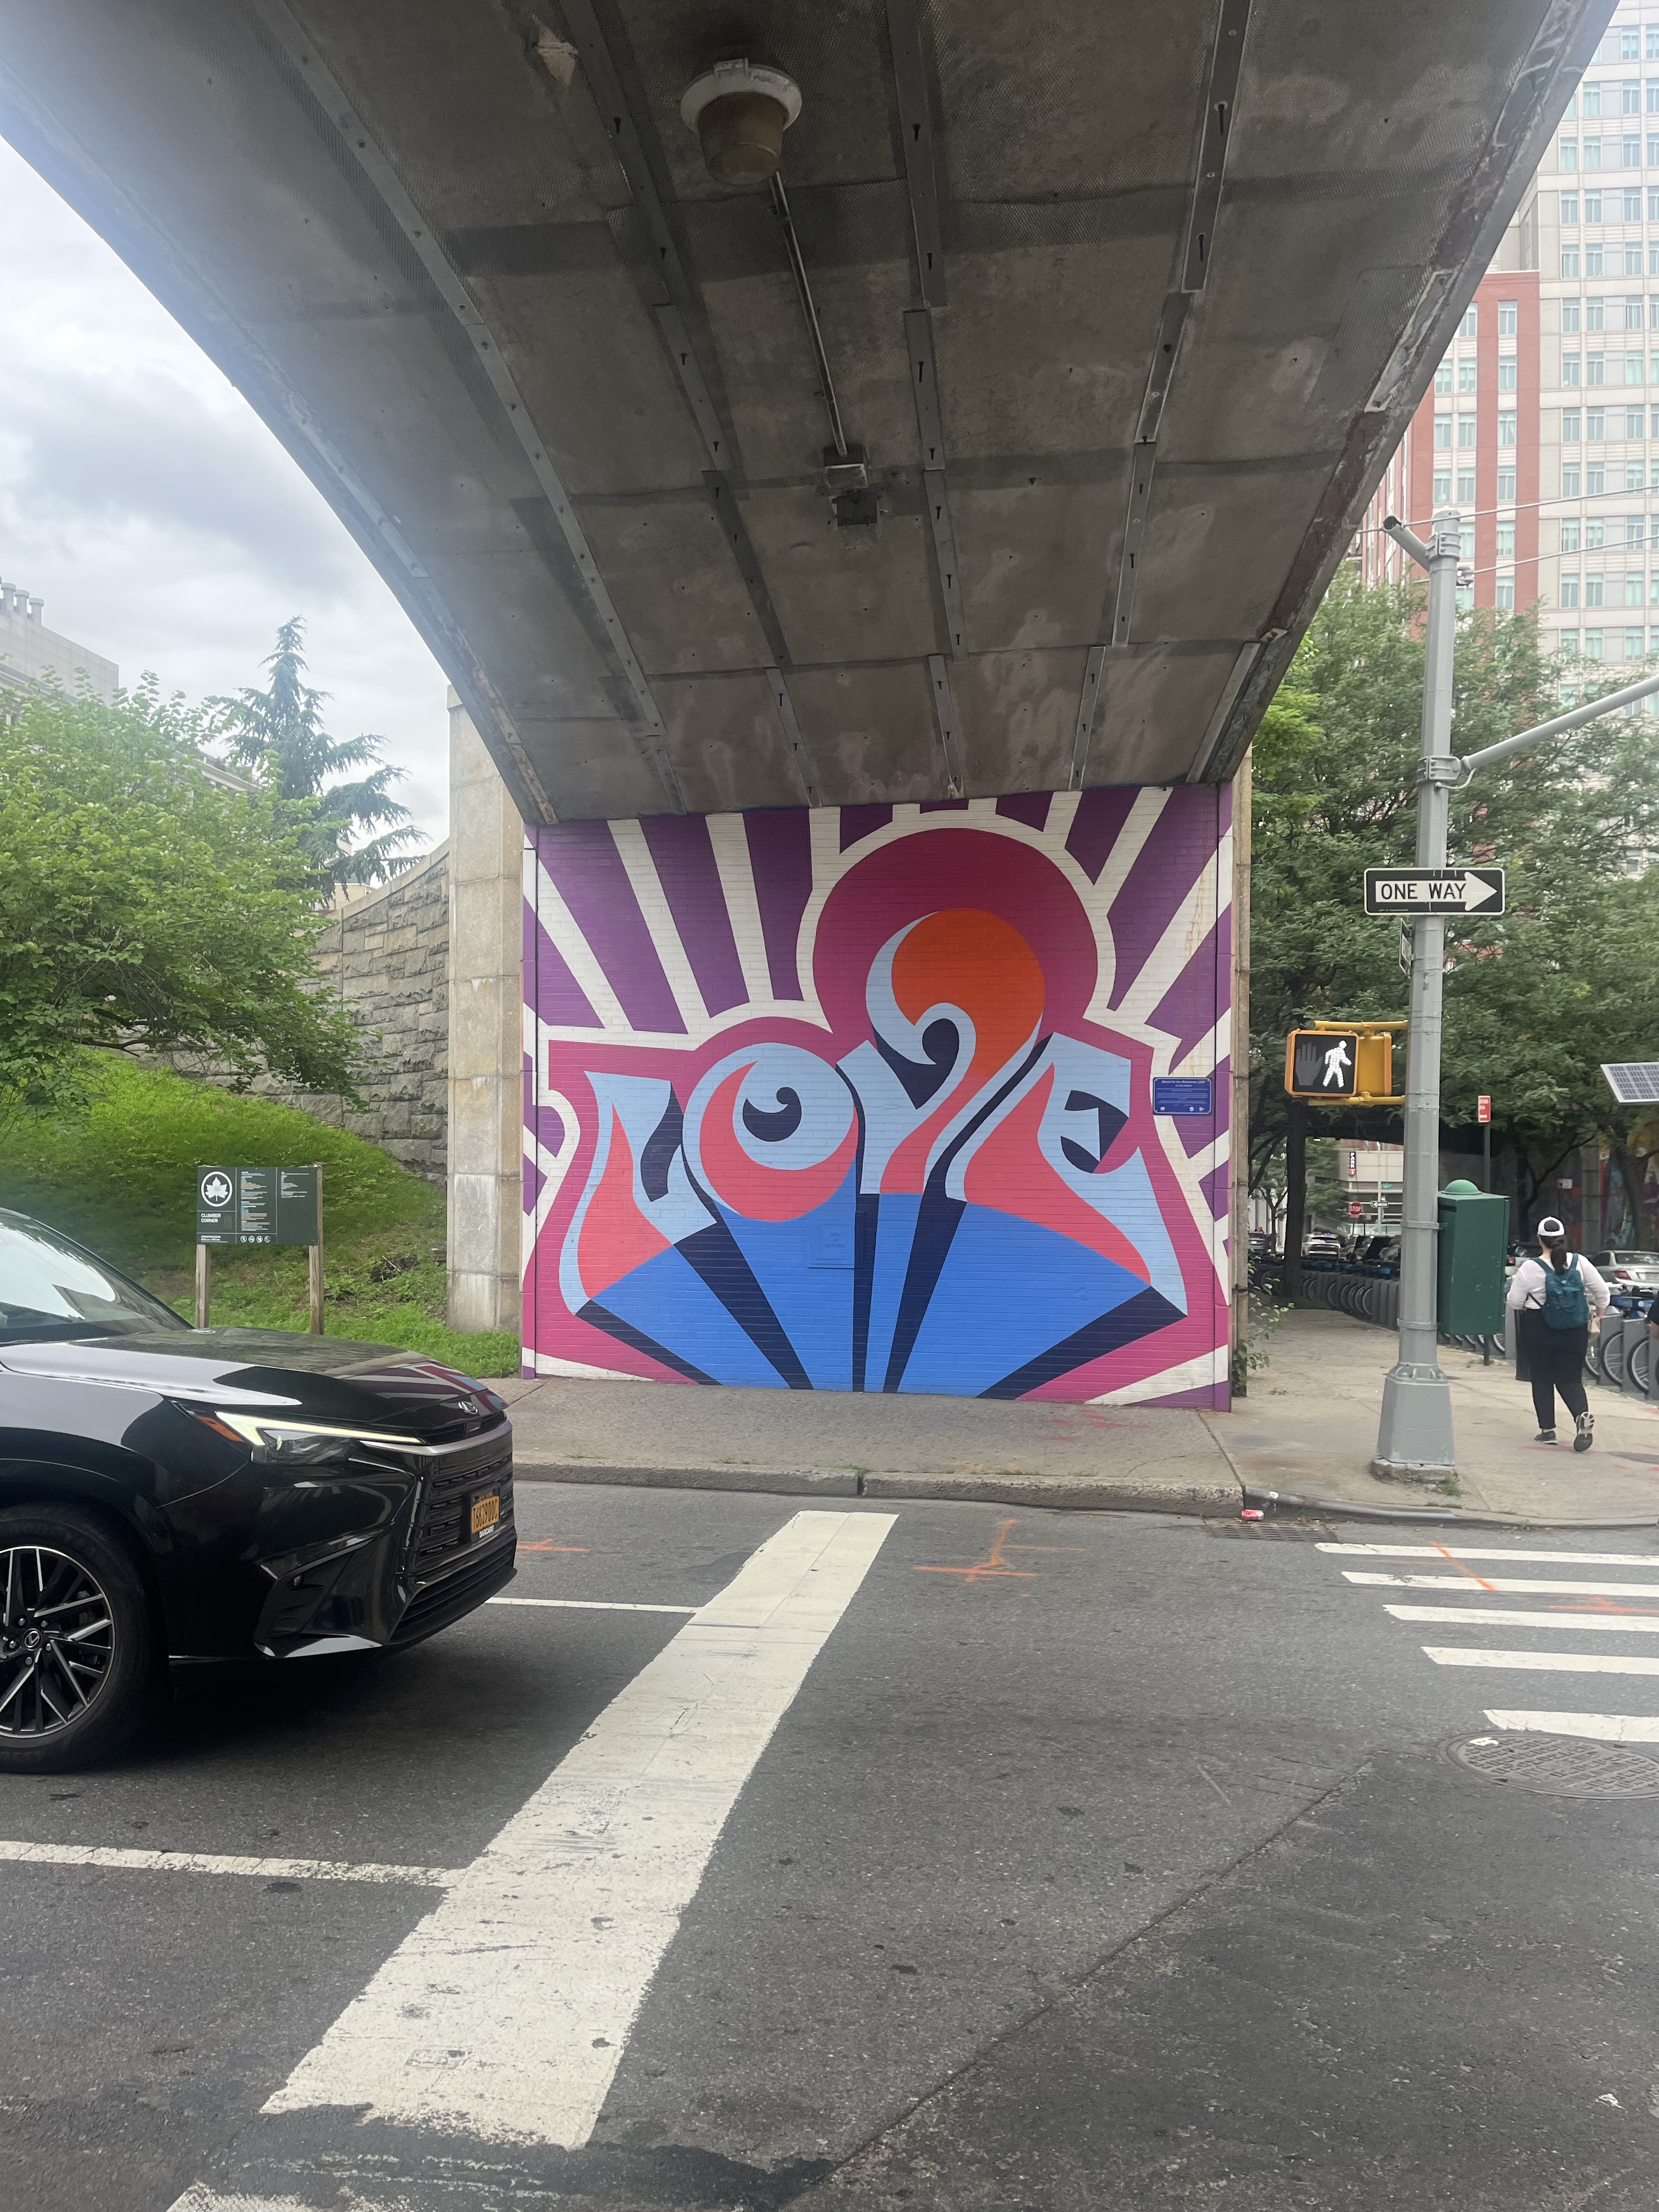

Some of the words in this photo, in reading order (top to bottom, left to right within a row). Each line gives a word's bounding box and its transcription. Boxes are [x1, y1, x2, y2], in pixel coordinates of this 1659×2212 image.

[1381, 883, 1418, 900] ONE
[1428, 883, 1466, 900] WAY
[560, 908, 1188, 1317] LOVE
